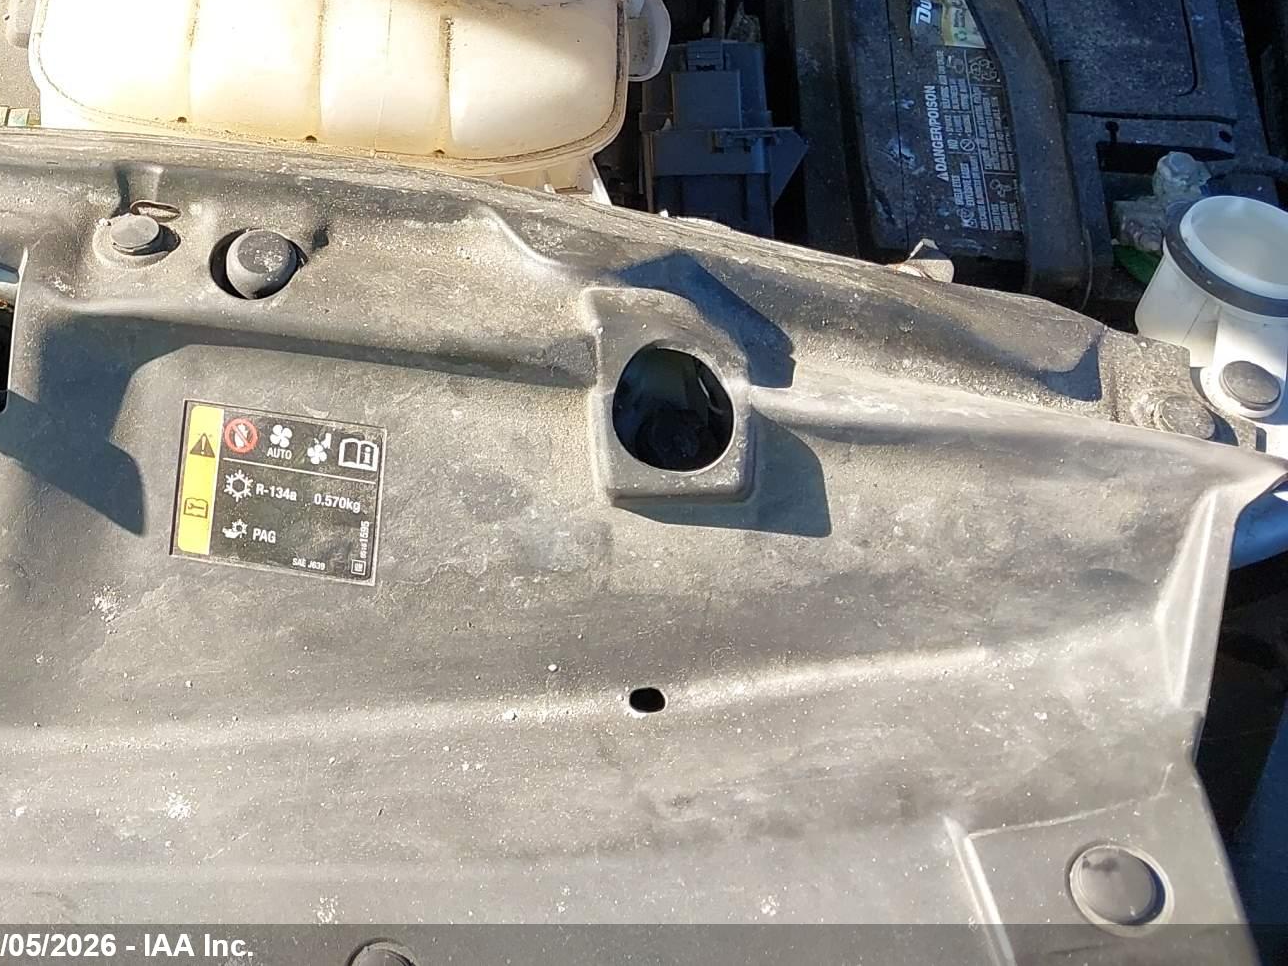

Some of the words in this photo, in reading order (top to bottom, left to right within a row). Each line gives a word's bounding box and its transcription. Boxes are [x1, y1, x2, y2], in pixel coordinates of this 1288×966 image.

[923, 85, 948, 172] DANGER/POISON
[947, 139, 959, 150] NO
[266, 448, 293, 460] AUTO
[255, 484, 298, 502] R-134a
[314, 493, 361, 514] 0.570kg
[252, 528, 277, 543] PAG
[292, 557, 307, 568] SAE
[307, 560, 326, 571] J639
